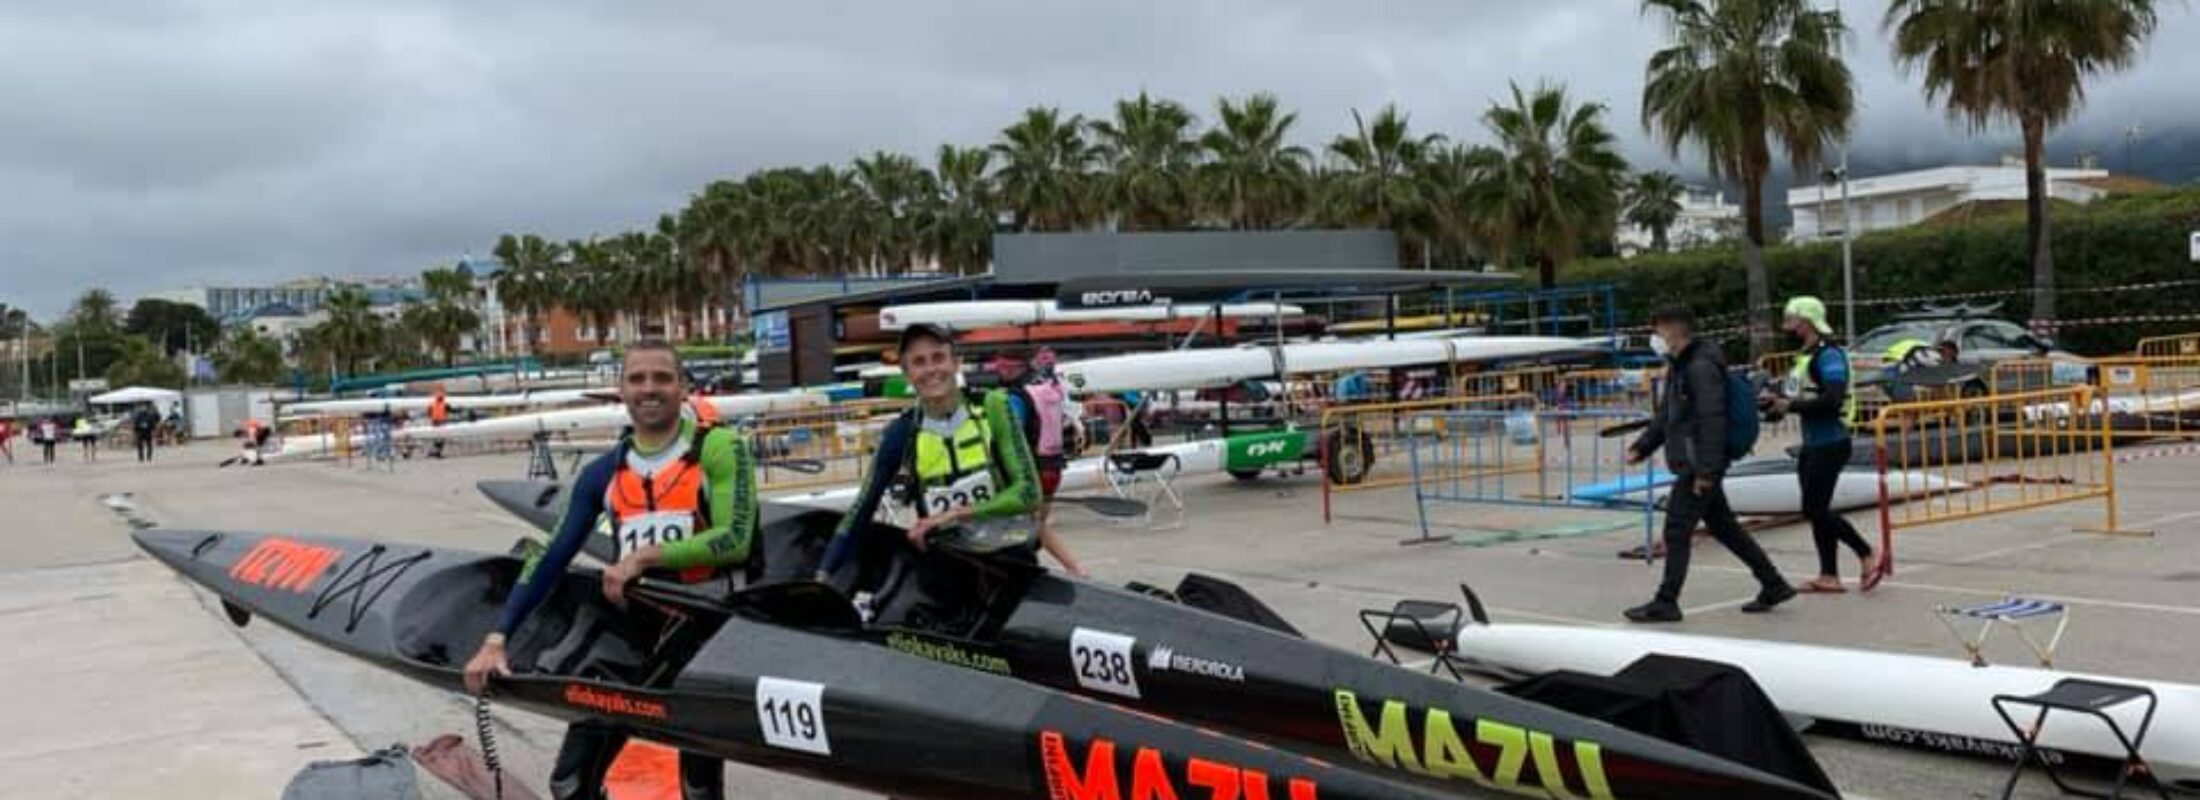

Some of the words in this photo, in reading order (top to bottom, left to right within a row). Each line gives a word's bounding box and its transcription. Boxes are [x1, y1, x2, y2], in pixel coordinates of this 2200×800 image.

[1076, 646, 1129, 685] 238
[763, 697, 816, 740] 119
[1335, 689, 1615, 800] MAZU
[1862, 722, 2064, 765] elkayaks.com
